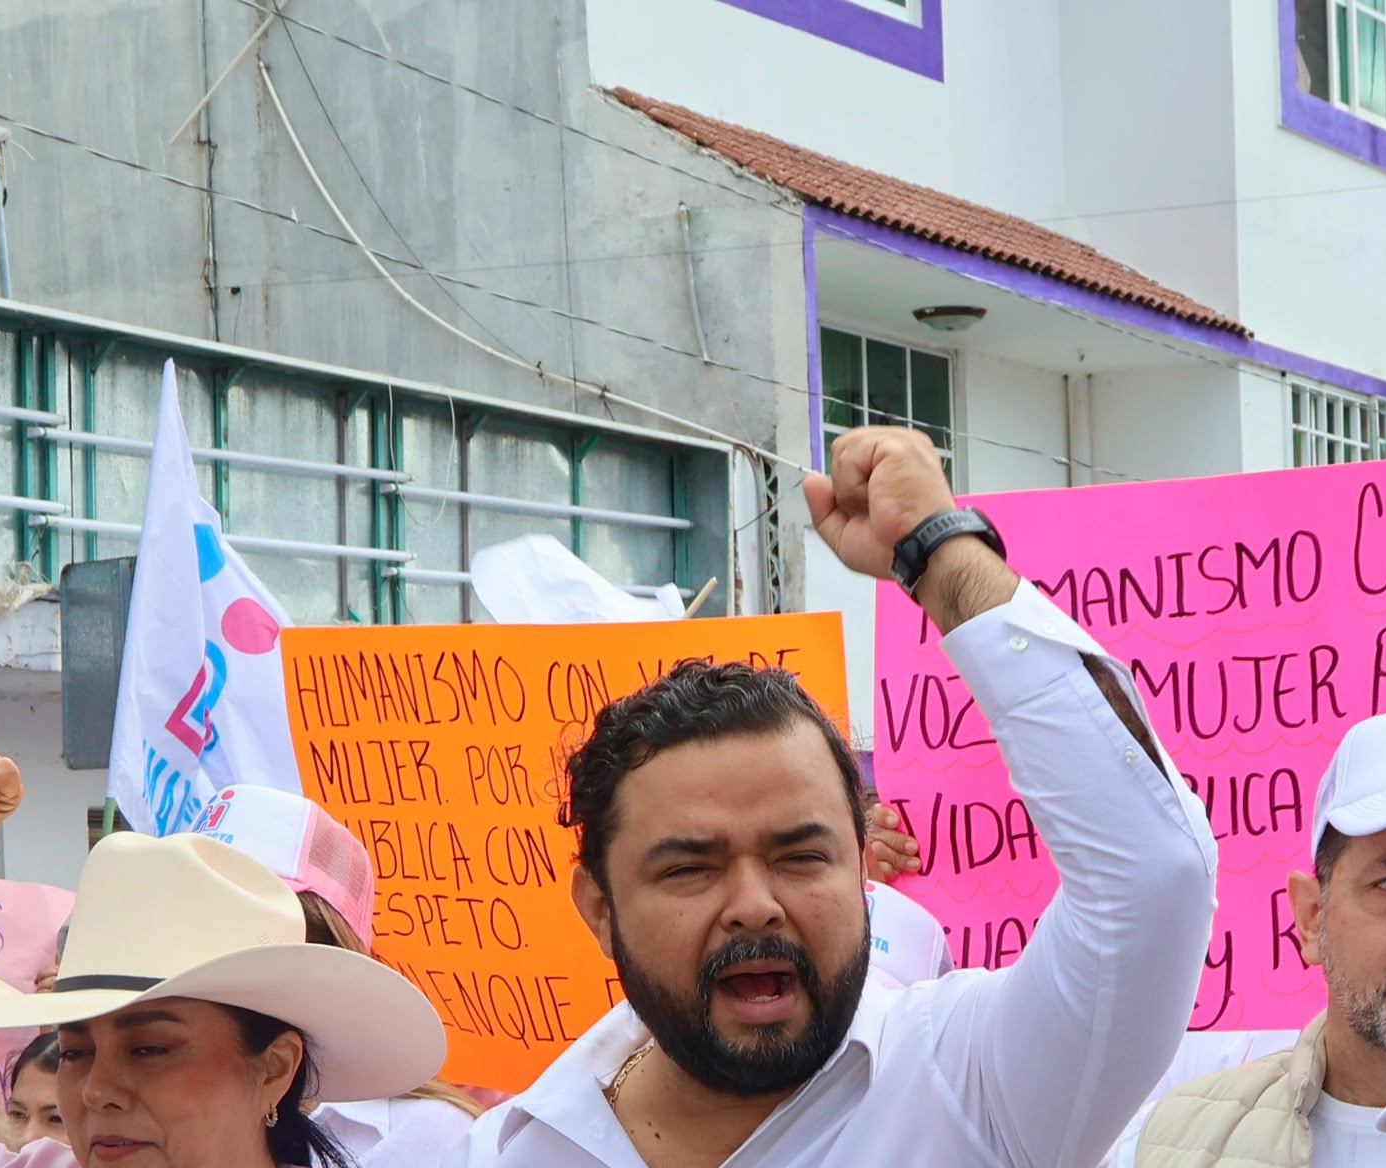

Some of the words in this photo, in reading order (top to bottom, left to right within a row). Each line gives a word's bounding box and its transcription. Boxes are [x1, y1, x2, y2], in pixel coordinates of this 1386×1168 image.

[293, 648, 526, 731] HUMANISMO
[547, 657, 612, 724] CON
[880, 672, 998, 754] VOZ
[1130, 645, 1347, 739] MUJER
[465, 743, 536, 808] POR
[484, 823, 557, 888] CON
[896, 791, 1038, 878] VIDA
